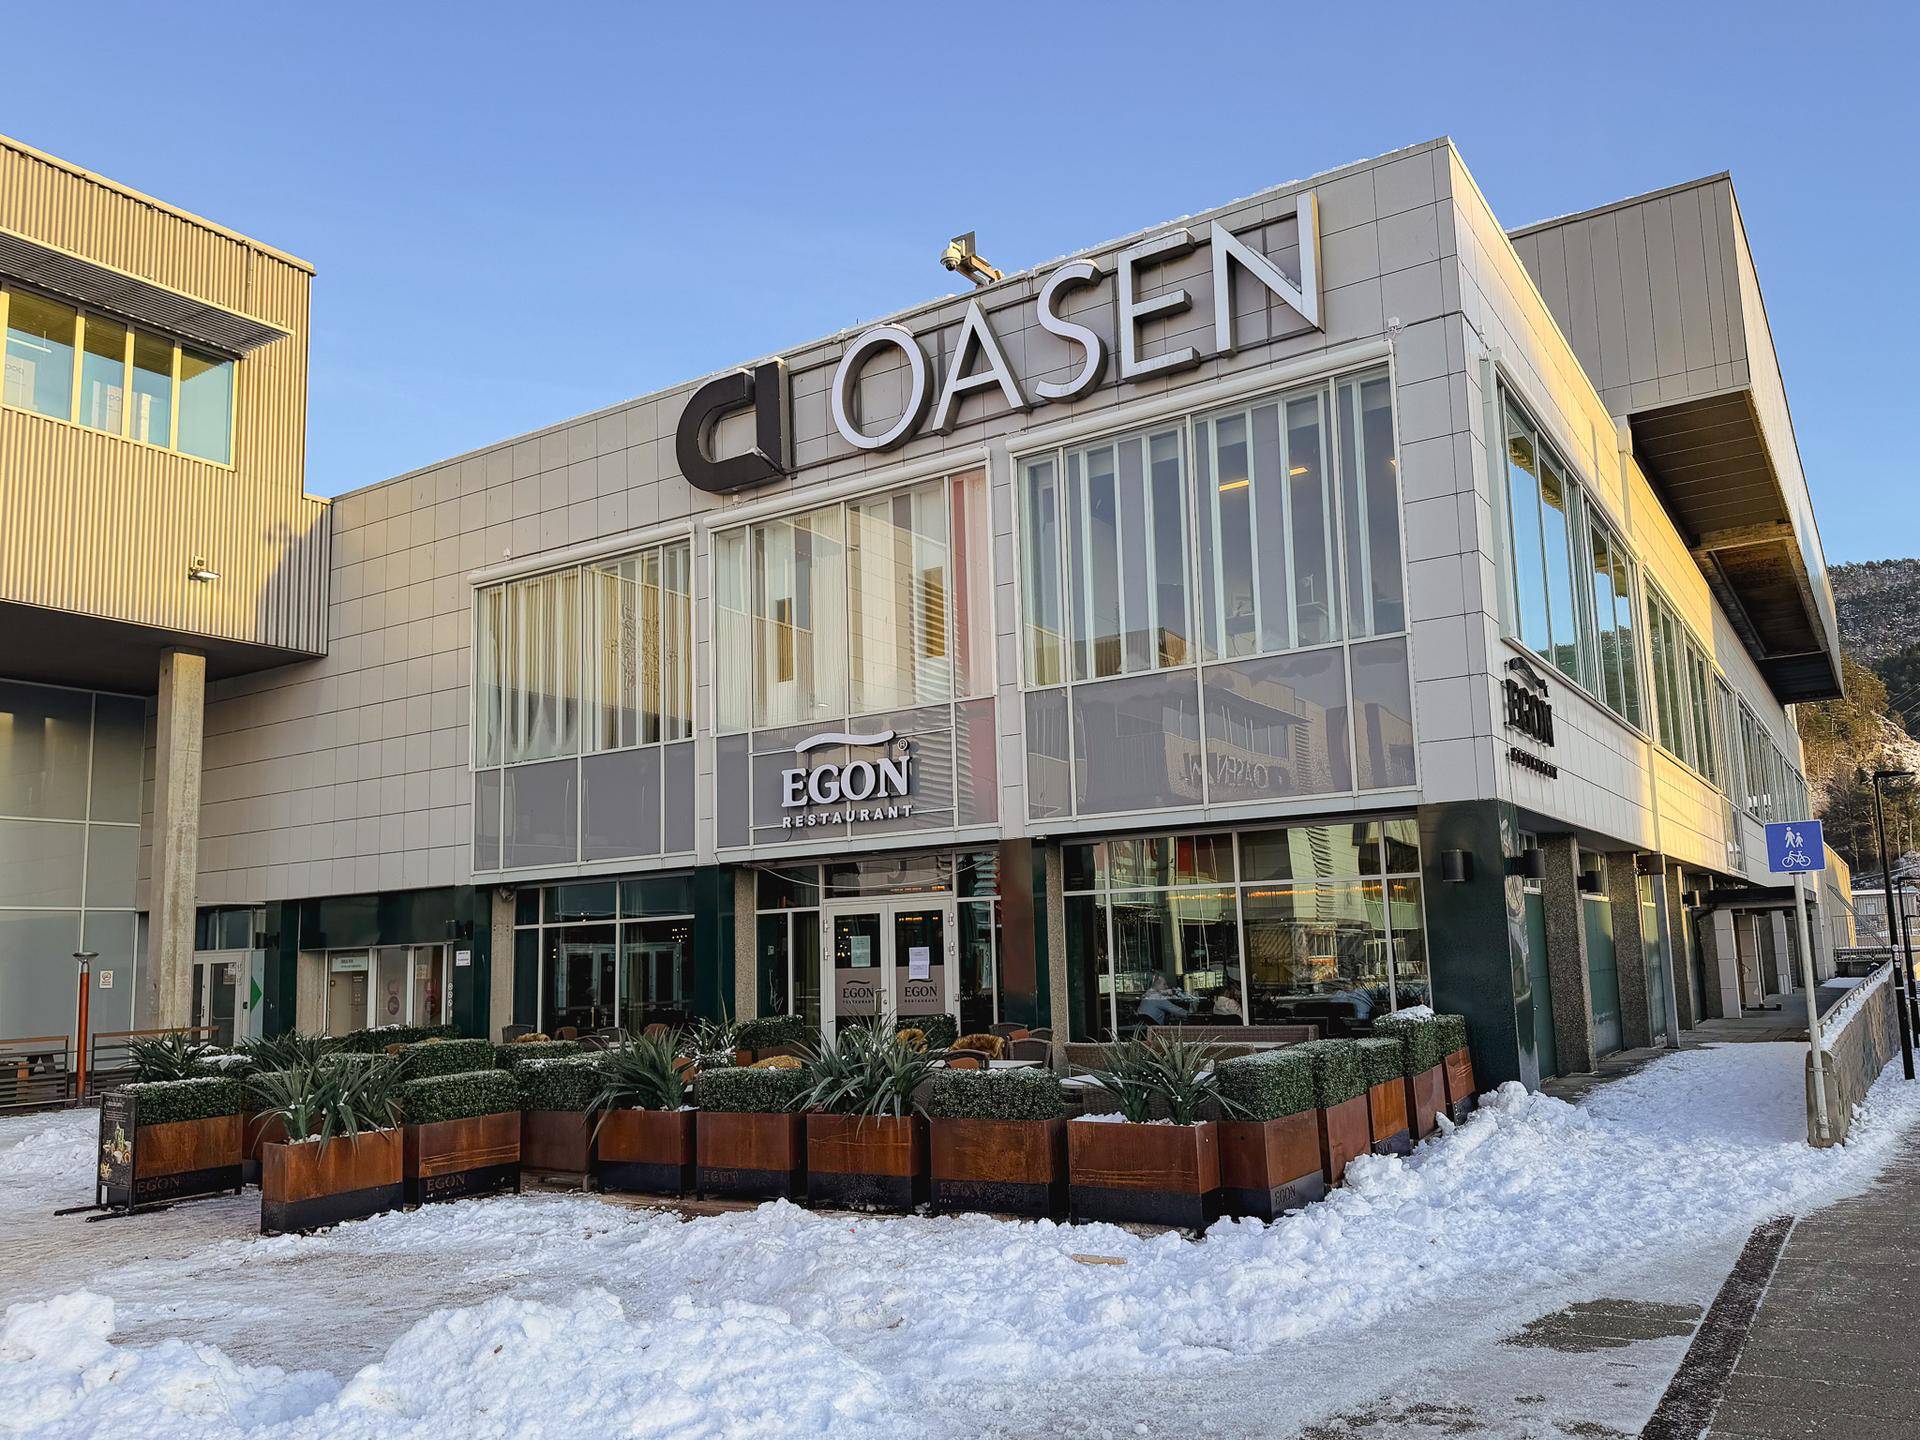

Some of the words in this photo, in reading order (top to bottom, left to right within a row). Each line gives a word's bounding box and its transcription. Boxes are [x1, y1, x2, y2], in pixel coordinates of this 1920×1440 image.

[832, 191, 1325, 453] OASEN
[781, 755, 911, 808] EGON
[782, 804, 914, 829] RESTAURANT
[842, 987, 874, 999] EGON
[904, 986, 938, 998] EGON
[426, 1174, 465, 1192] EGON
